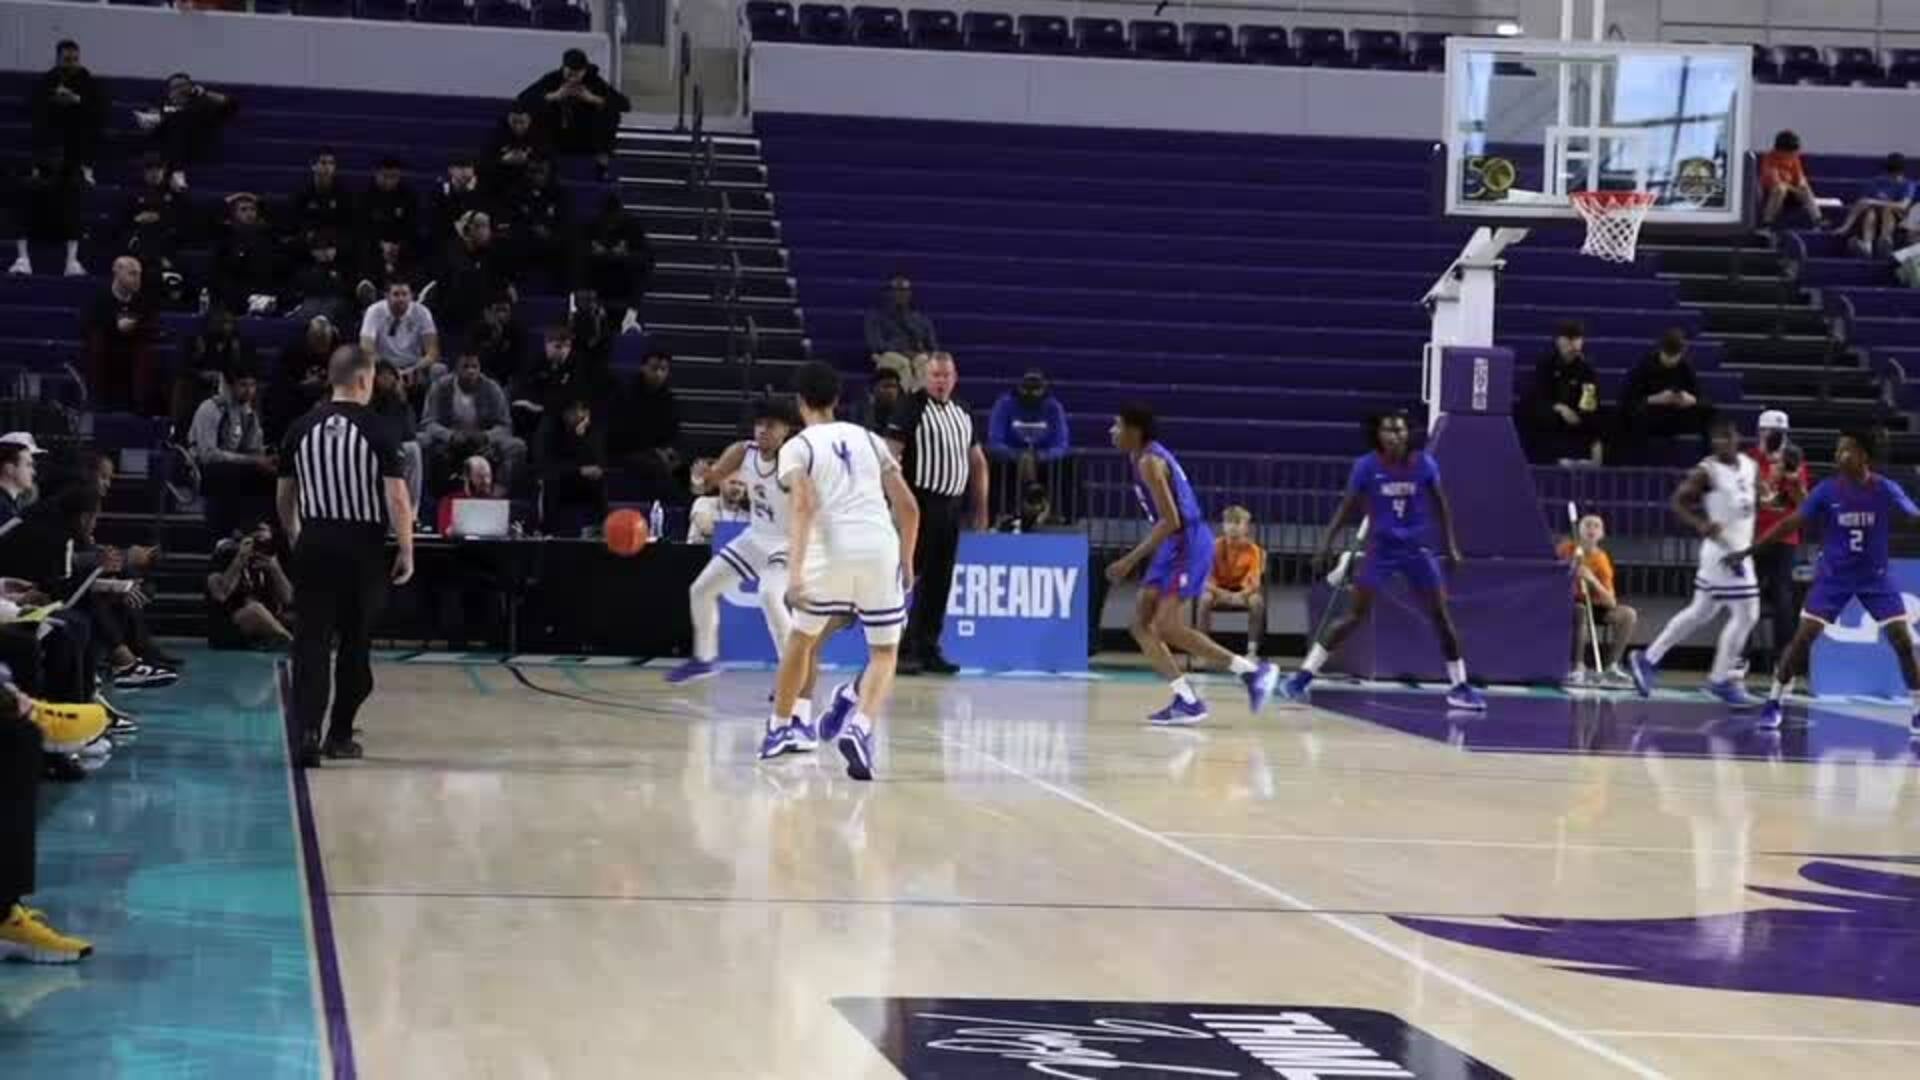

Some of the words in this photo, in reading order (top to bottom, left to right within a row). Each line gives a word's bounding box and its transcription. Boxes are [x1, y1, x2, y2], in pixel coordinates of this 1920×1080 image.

[831, 440, 852, 475] 4
[1391, 499, 1407, 519] 4
[1838, 511, 1876, 527] NORTH
[1850, 529, 1864, 552] 2
